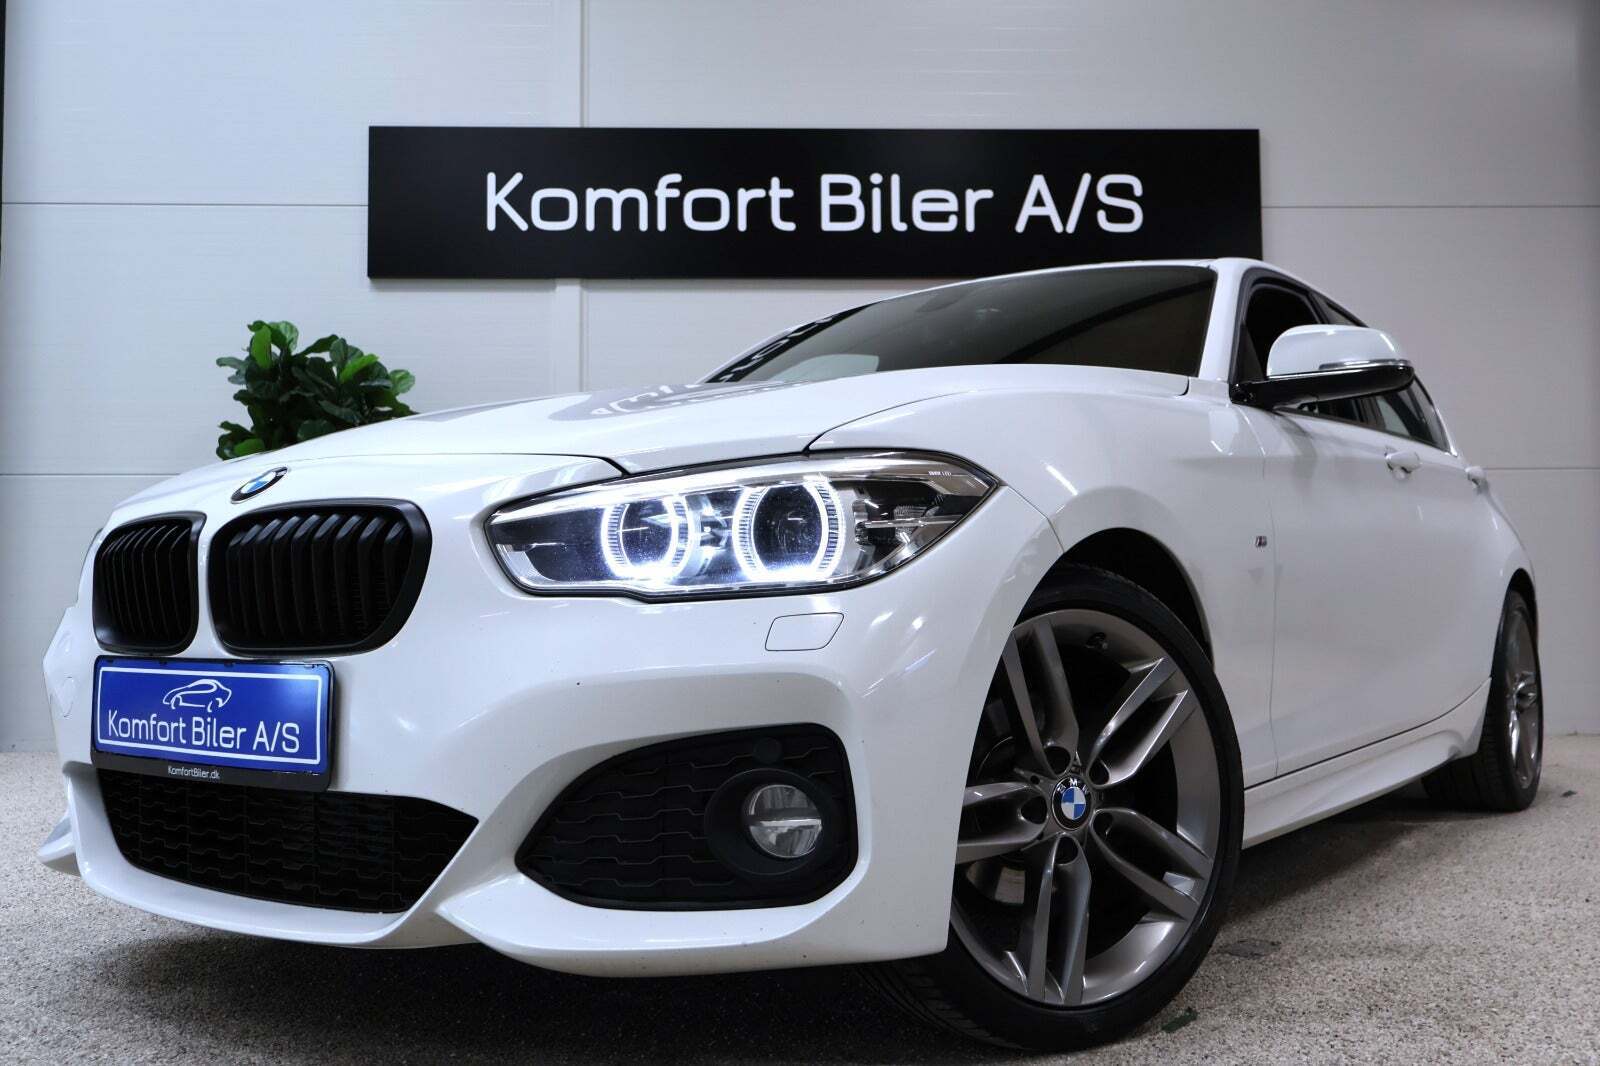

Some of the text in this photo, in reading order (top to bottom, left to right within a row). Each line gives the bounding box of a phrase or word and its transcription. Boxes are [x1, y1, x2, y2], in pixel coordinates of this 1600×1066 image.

[486, 172, 1144, 233] Komfort Biler A/S
[108, 709, 300, 753] Komfort Biler A/S
[167, 765, 221, 780] KomfortBiler.dk
